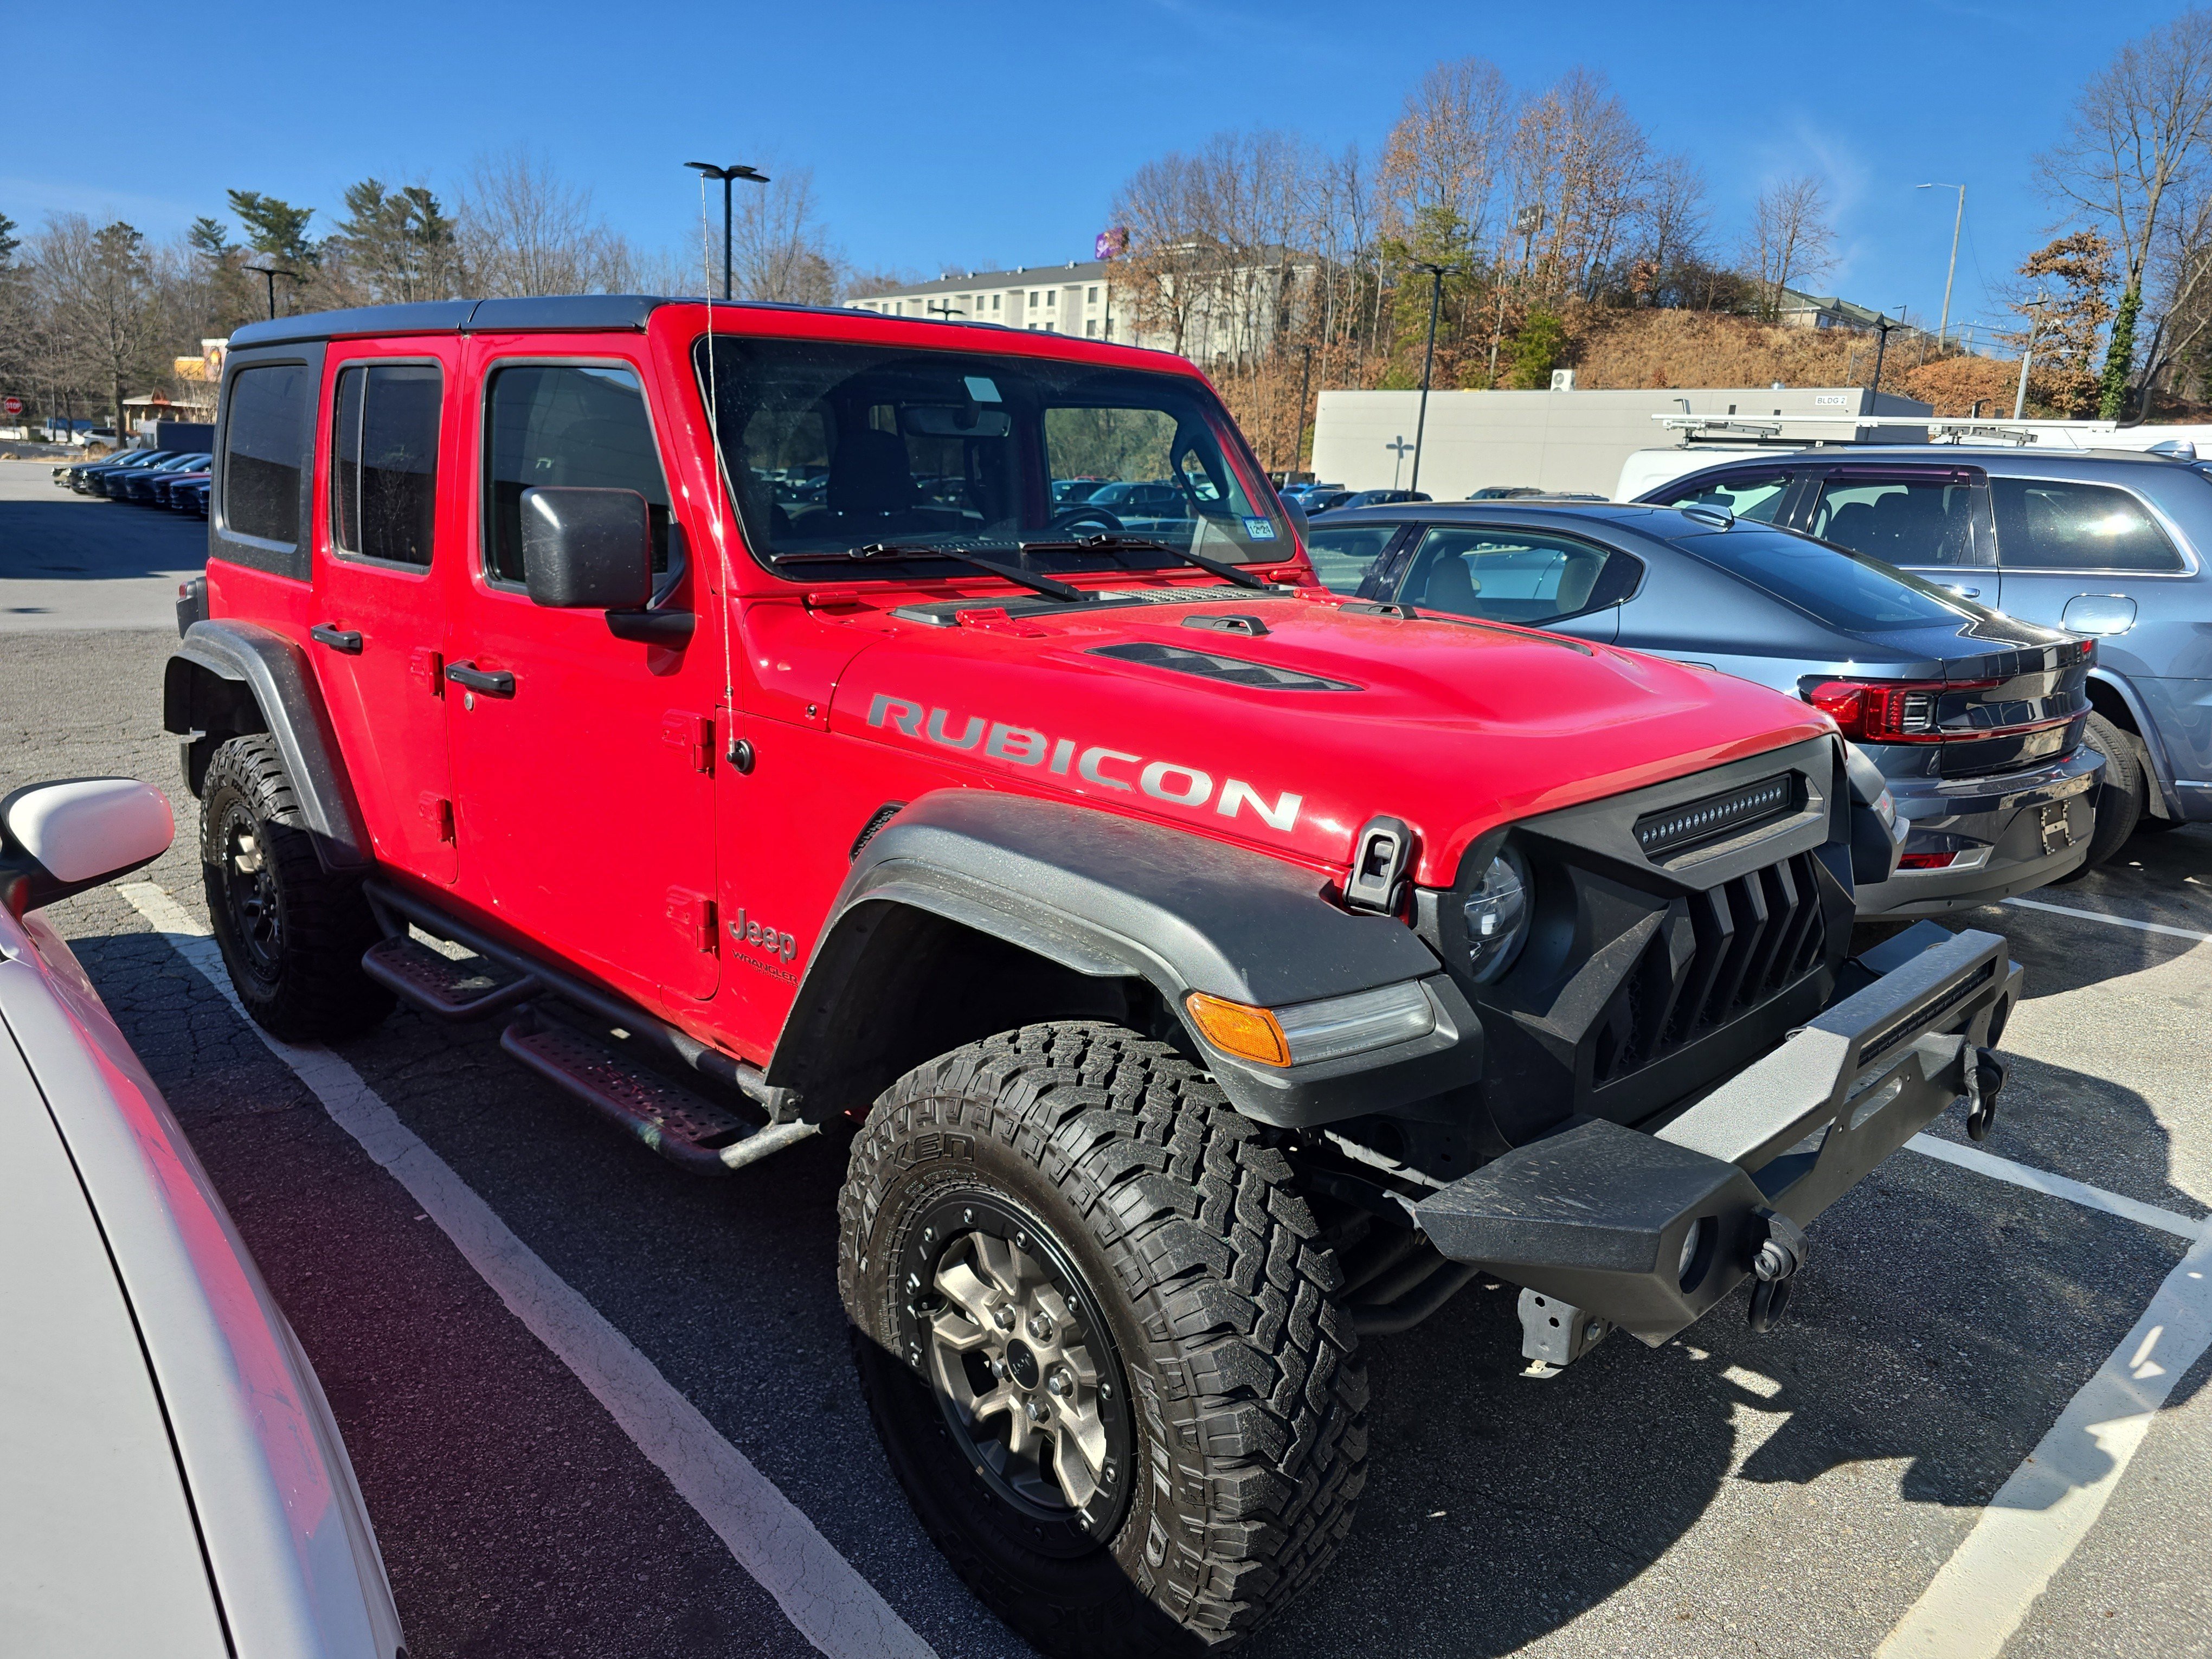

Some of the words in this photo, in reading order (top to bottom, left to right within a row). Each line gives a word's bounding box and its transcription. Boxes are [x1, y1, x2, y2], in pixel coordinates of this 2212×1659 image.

[5, 402, 21, 410] STOP
[866, 693, 1304, 832] RUBICON
[728, 907, 798, 965] Jeep
[732, 949, 799, 985] WRANGLER
